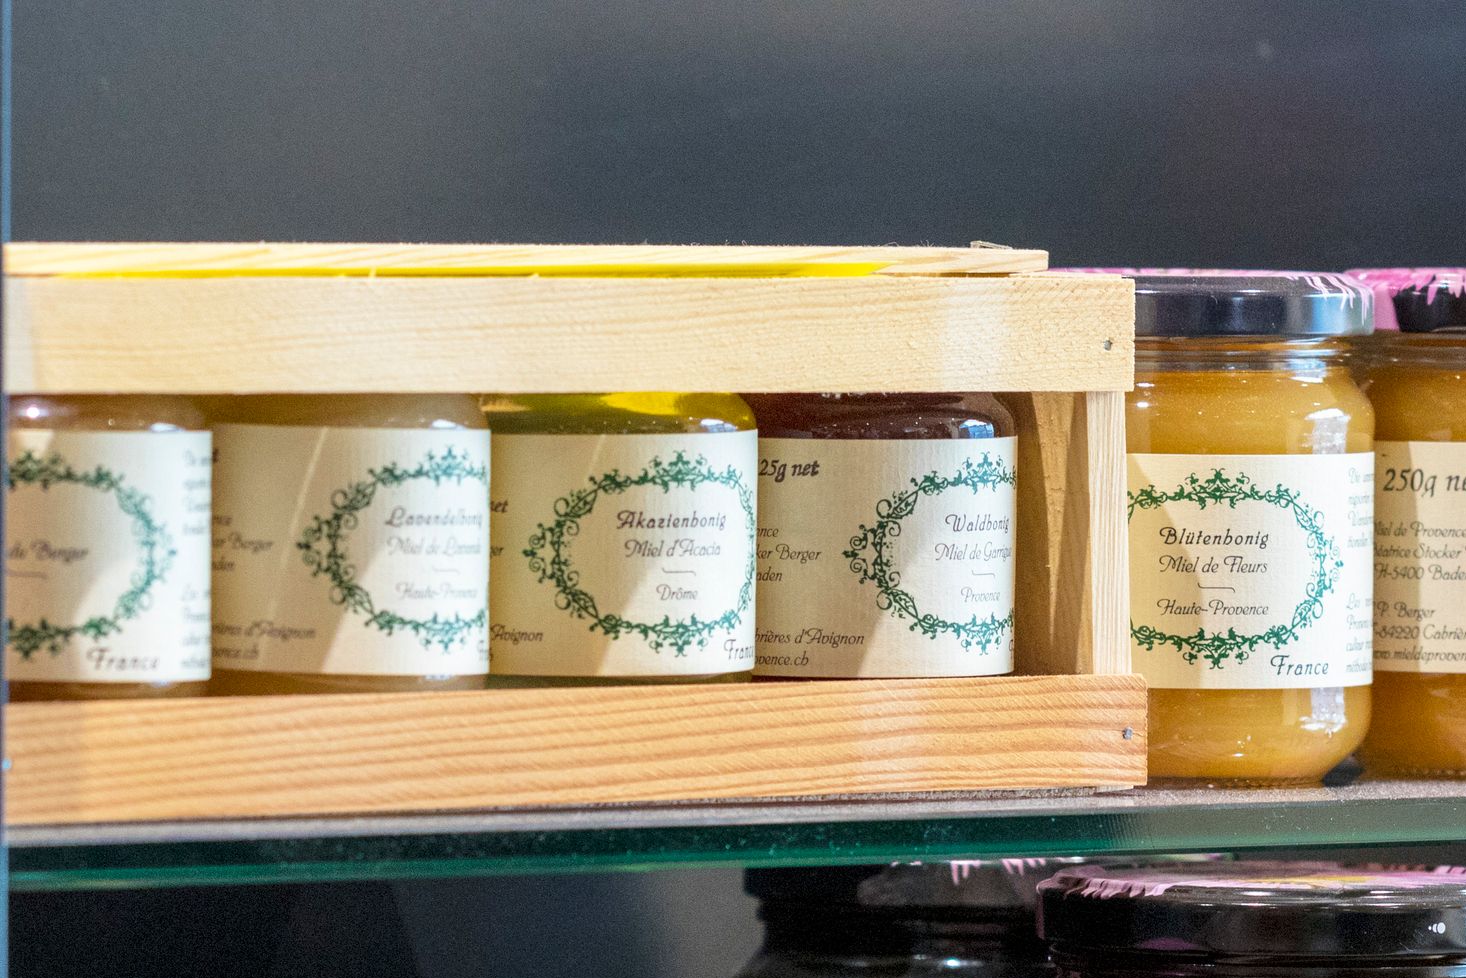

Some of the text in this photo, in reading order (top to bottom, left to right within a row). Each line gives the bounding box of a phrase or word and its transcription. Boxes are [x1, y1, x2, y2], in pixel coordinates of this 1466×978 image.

[758, 459, 820, 482] 25g net
[1383, 467, 1438, 498] 250g
[616, 509, 727, 531] Akazienhonig
[1394, 522, 1408, 538] de
[1158, 526, 1269, 549] Blütenhonig
[624, 537, 721, 559] Miel d'Acacia
[775, 543, 821, 563] Berger
[934, 542, 982, 561] Miel de
[1412, 543, 1462, 560] Stocker
[1158, 555, 1268, 575] Miel de Fleurs
[1374, 564, 1425, 581] H-5400
[757, 569, 783, 582] aden
[656, 583, 698, 601] Drôme
[960, 586, 1001, 603] Provence
[1156, 598, 1269, 616] Haute-Provence
[1394, 602, 1436, 622] Berger
[491, 623, 543, 646] Avignon
[755, 626, 865, 646] brières d'Avignon
[1374, 623, 1420, 641] -84220
[1270, 654, 1329, 676] France
